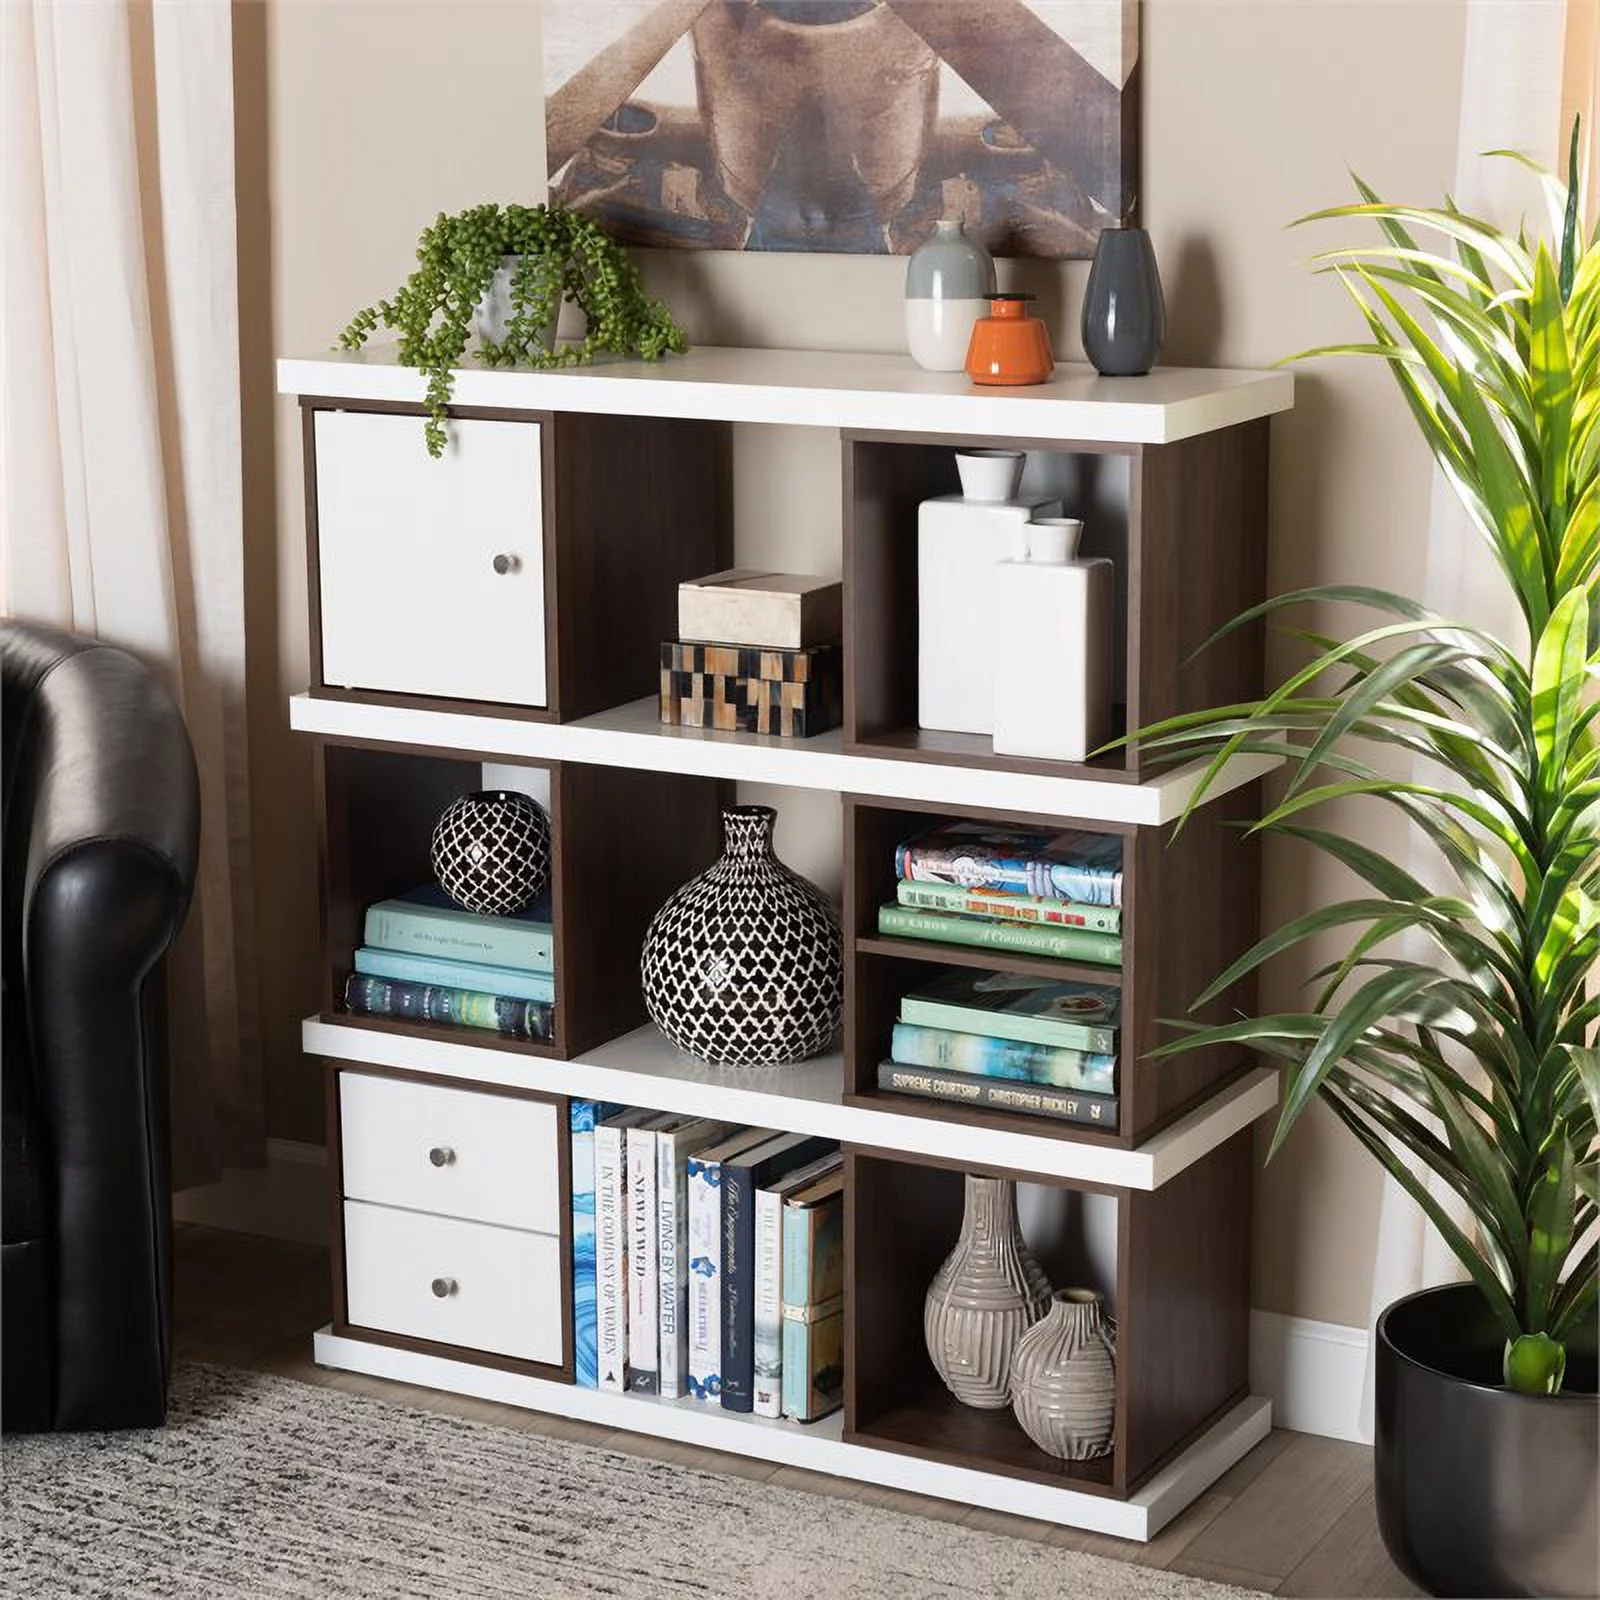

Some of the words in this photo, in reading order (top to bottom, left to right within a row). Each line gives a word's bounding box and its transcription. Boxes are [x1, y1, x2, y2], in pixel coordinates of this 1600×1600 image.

[908, 918, 948, 931] KARON
[892, 1073, 932, 1091] SUPREME
[932, 1079, 981, 1100] COURTSHIP
[987, 1088, 1041, 1109] CHRISTOPHER
[1041, 1096, 1079, 1115] BUCKLEY
[601, 1165, 614, 1179] IN
[602, 1183, 614, 1213] THE
[634, 1173, 646, 1277] NEWLYWED
[661, 1199, 674, 1252] LIVING
[602, 1215, 616, 1278] COMPANY
[661, 1255, 675, 1278] BY
[603, 1283, 616, 1303] OF
[662, 1281, 676, 1335] WATER
[604, 1304, 617, 1355] WOMEN
